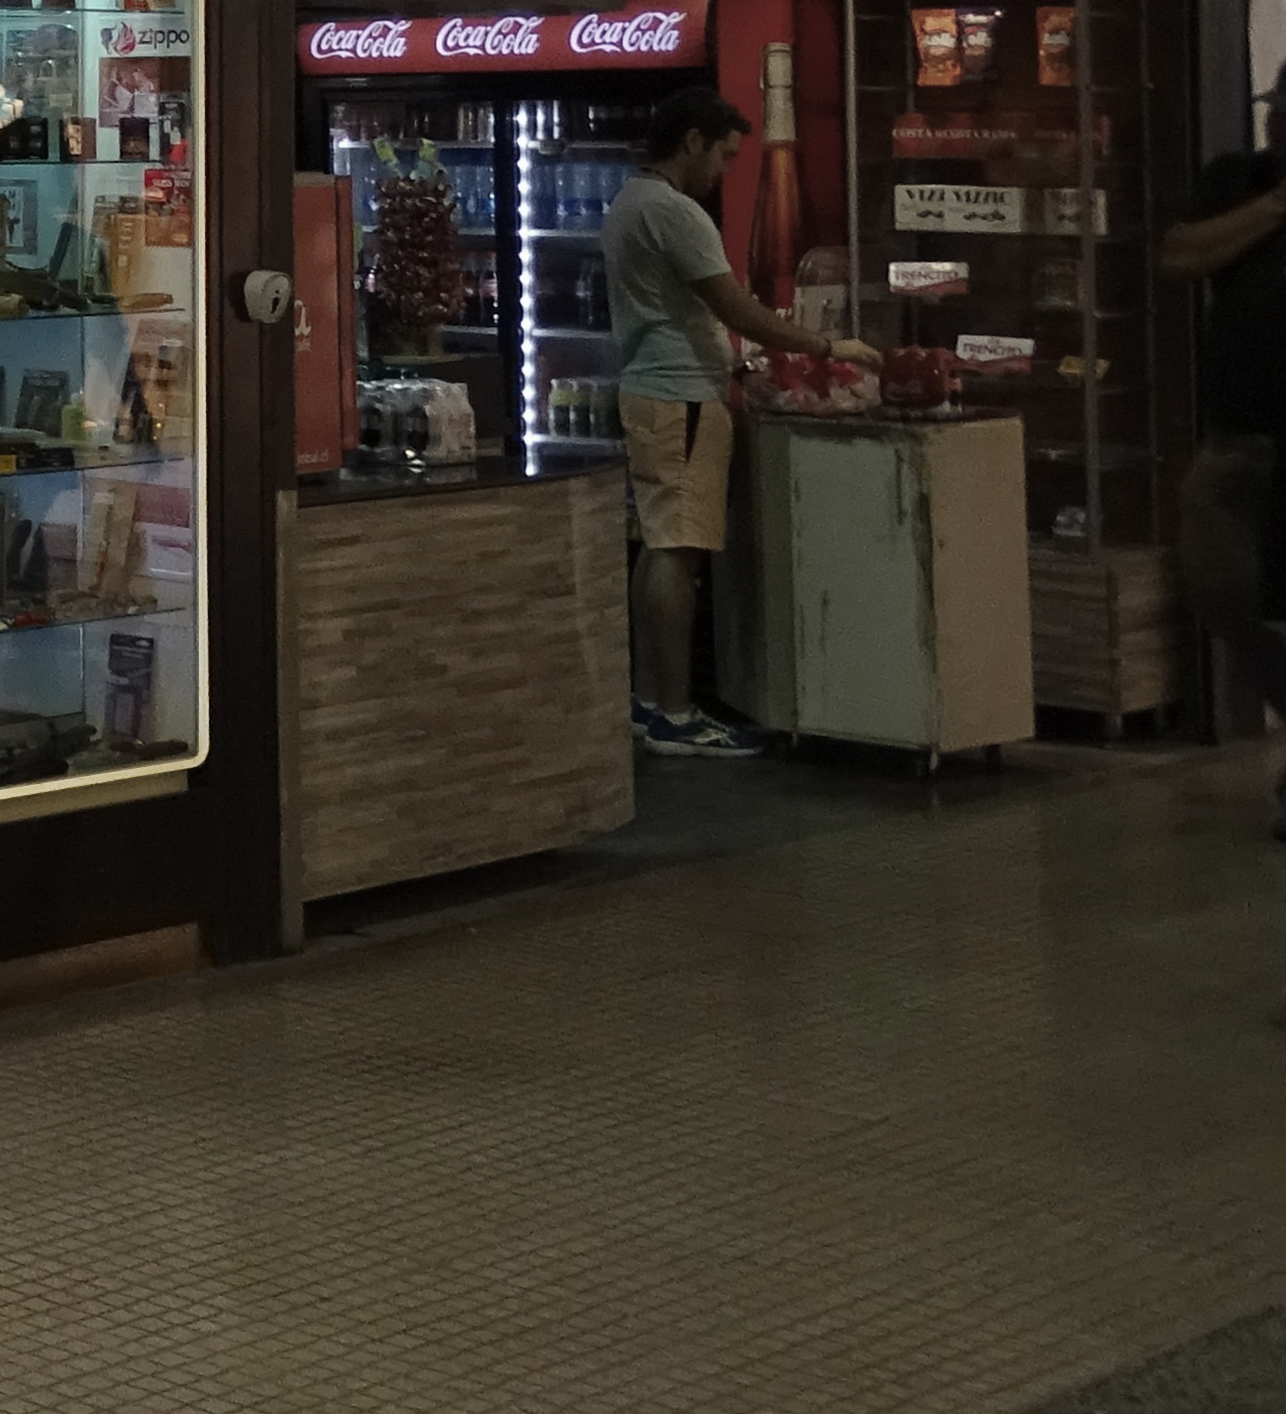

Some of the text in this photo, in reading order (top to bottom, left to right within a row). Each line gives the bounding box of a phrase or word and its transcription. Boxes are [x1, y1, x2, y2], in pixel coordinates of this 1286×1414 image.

[137, 27, 190, 49] zippo
[309, 20, 413, 60] Coca-Cola
[435, 15, 545, 57] Coca-Cola
[569, 11, 688, 53] Coca-Cola
